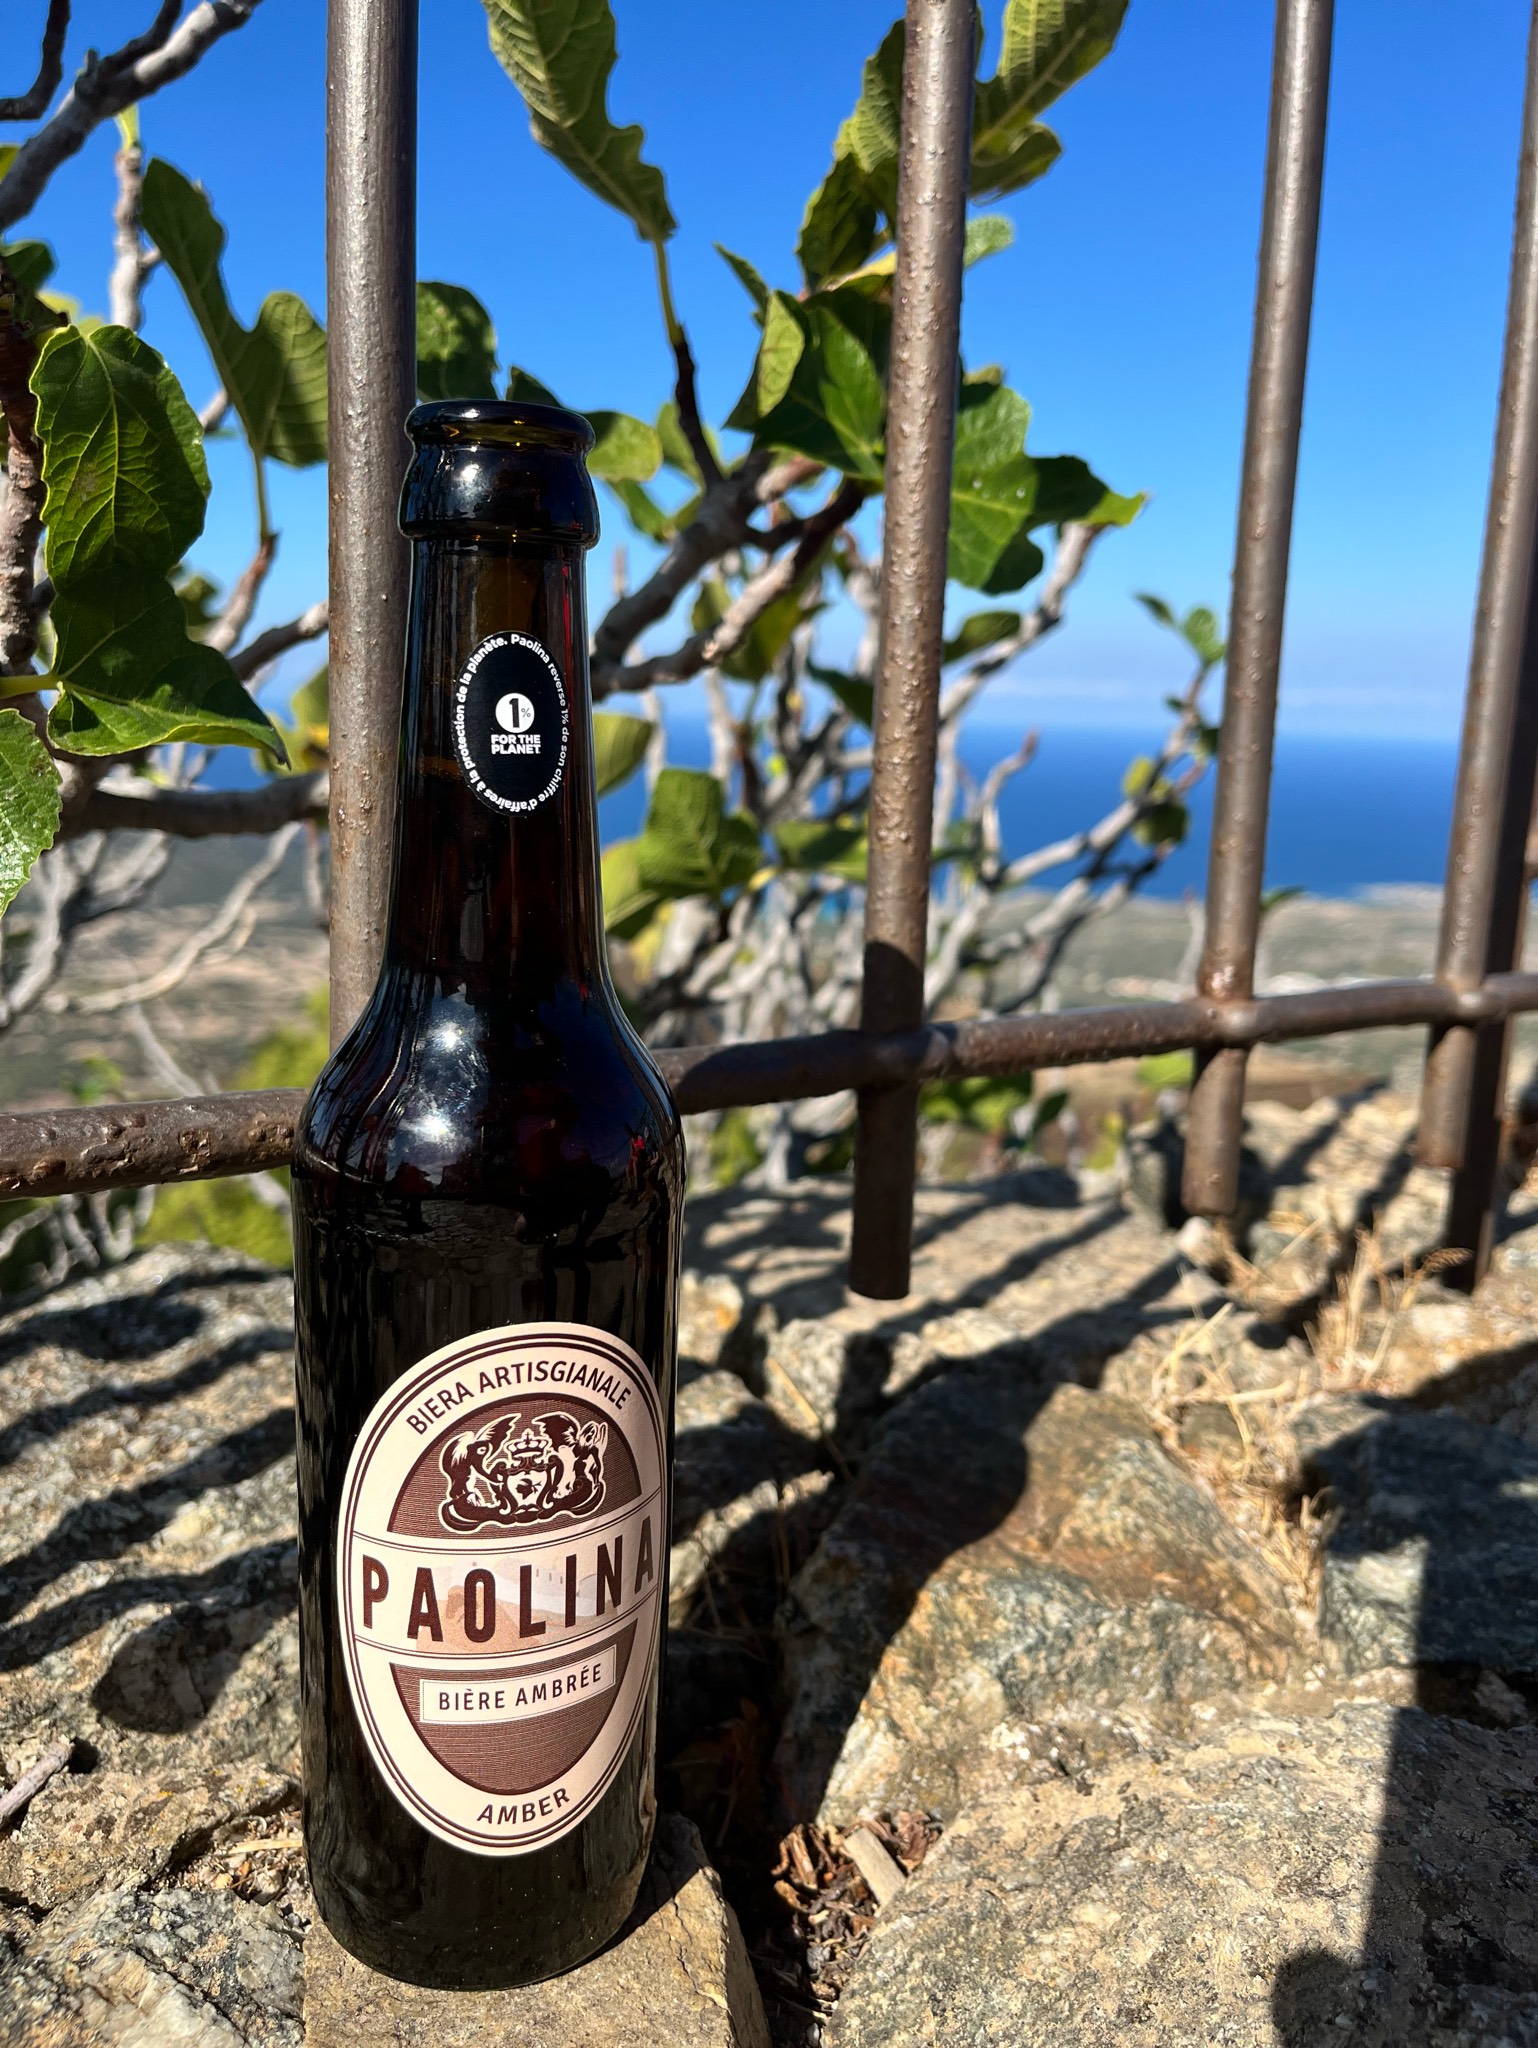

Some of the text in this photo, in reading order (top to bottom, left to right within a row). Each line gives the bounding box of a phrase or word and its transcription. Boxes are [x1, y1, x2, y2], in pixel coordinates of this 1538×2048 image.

[467, 637, 508, 674] planète.
[511, 633, 550, 663] Paolina
[460, 672, 472, 685] la
[548, 663, 566, 706] reverse
[456, 686, 468, 703] de
[454, 704, 476, 769] protection
[491, 734, 541, 745] FOR THE
[562, 727, 569, 743] de
[491, 744, 541, 755] PLANET
[558, 745, 567, 766] son
[469, 769, 480, 784] la
[476, 781, 486, 792] à
[538, 768, 562, 802] chiffre
[484, 788, 538, 812] d'affaires
[406, 1360, 632, 1435] BIERA ARTISGIANALE
[363, 1515, 654, 1643] PAOLINA
[438, 1662, 602, 1711] BIÈRE AMBRÉE
[477, 1787, 571, 1825] AMBER
